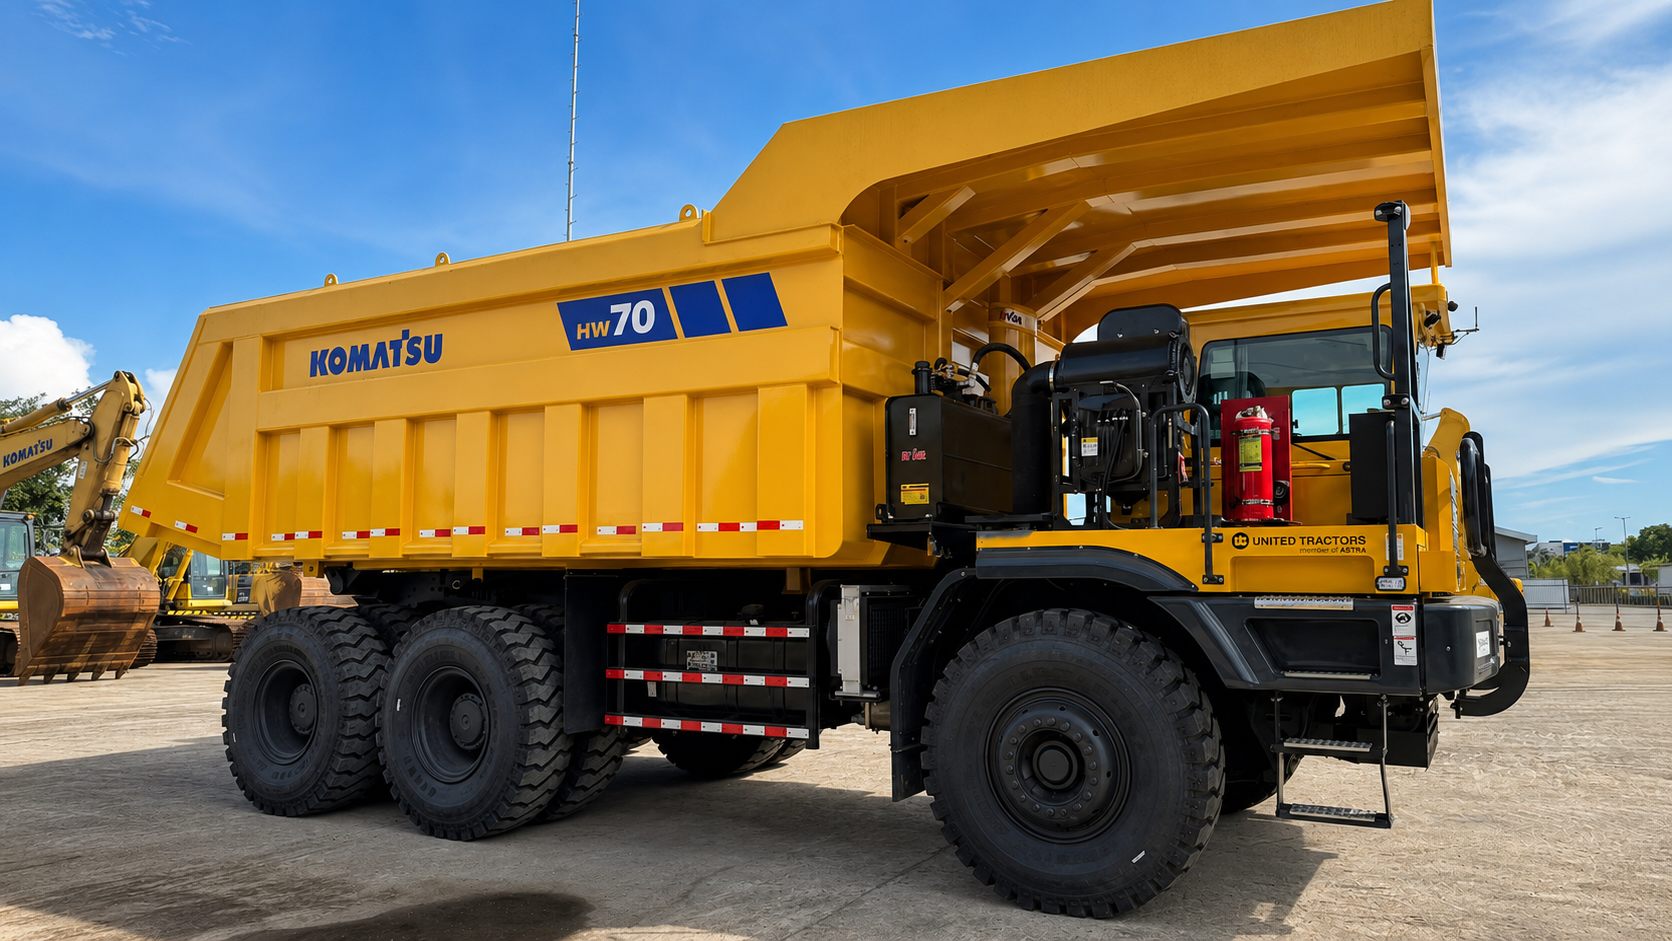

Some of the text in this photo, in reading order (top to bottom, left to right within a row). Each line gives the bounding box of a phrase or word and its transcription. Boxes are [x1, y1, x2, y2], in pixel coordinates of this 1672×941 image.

[309, 328, 443, 378] KOMATSU
[3, 438, 53, 468] KOMATSU
[1252, 536, 1296, 545] UNITED
[1299, 535, 1366, 545] TRACTORS
